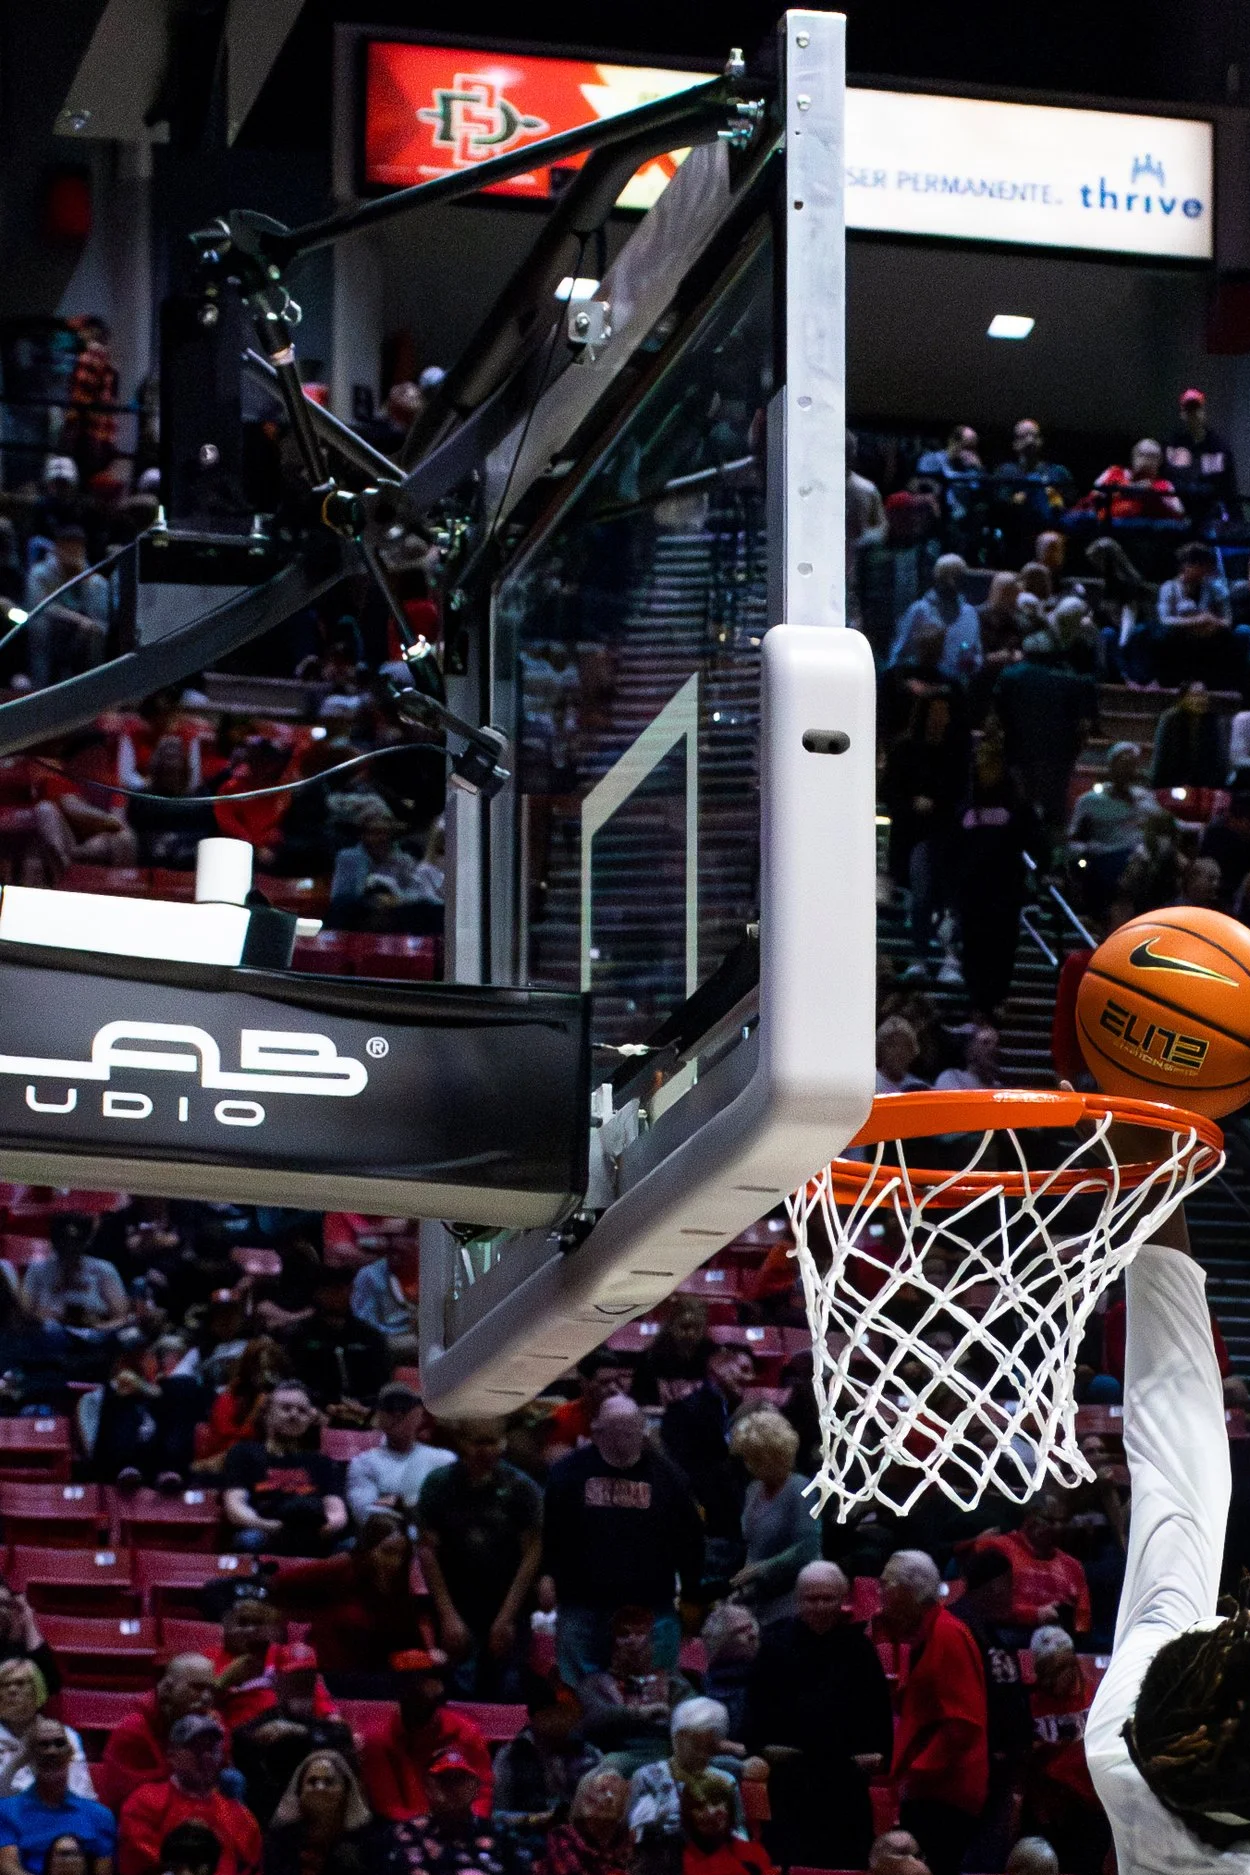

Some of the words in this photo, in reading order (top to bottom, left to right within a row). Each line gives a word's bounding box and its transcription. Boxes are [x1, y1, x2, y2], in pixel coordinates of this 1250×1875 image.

[846, 166, 887, 190] SER
[1080, 176, 1204, 219] thrive
[1099, 998, 1210, 1070] ELITE
